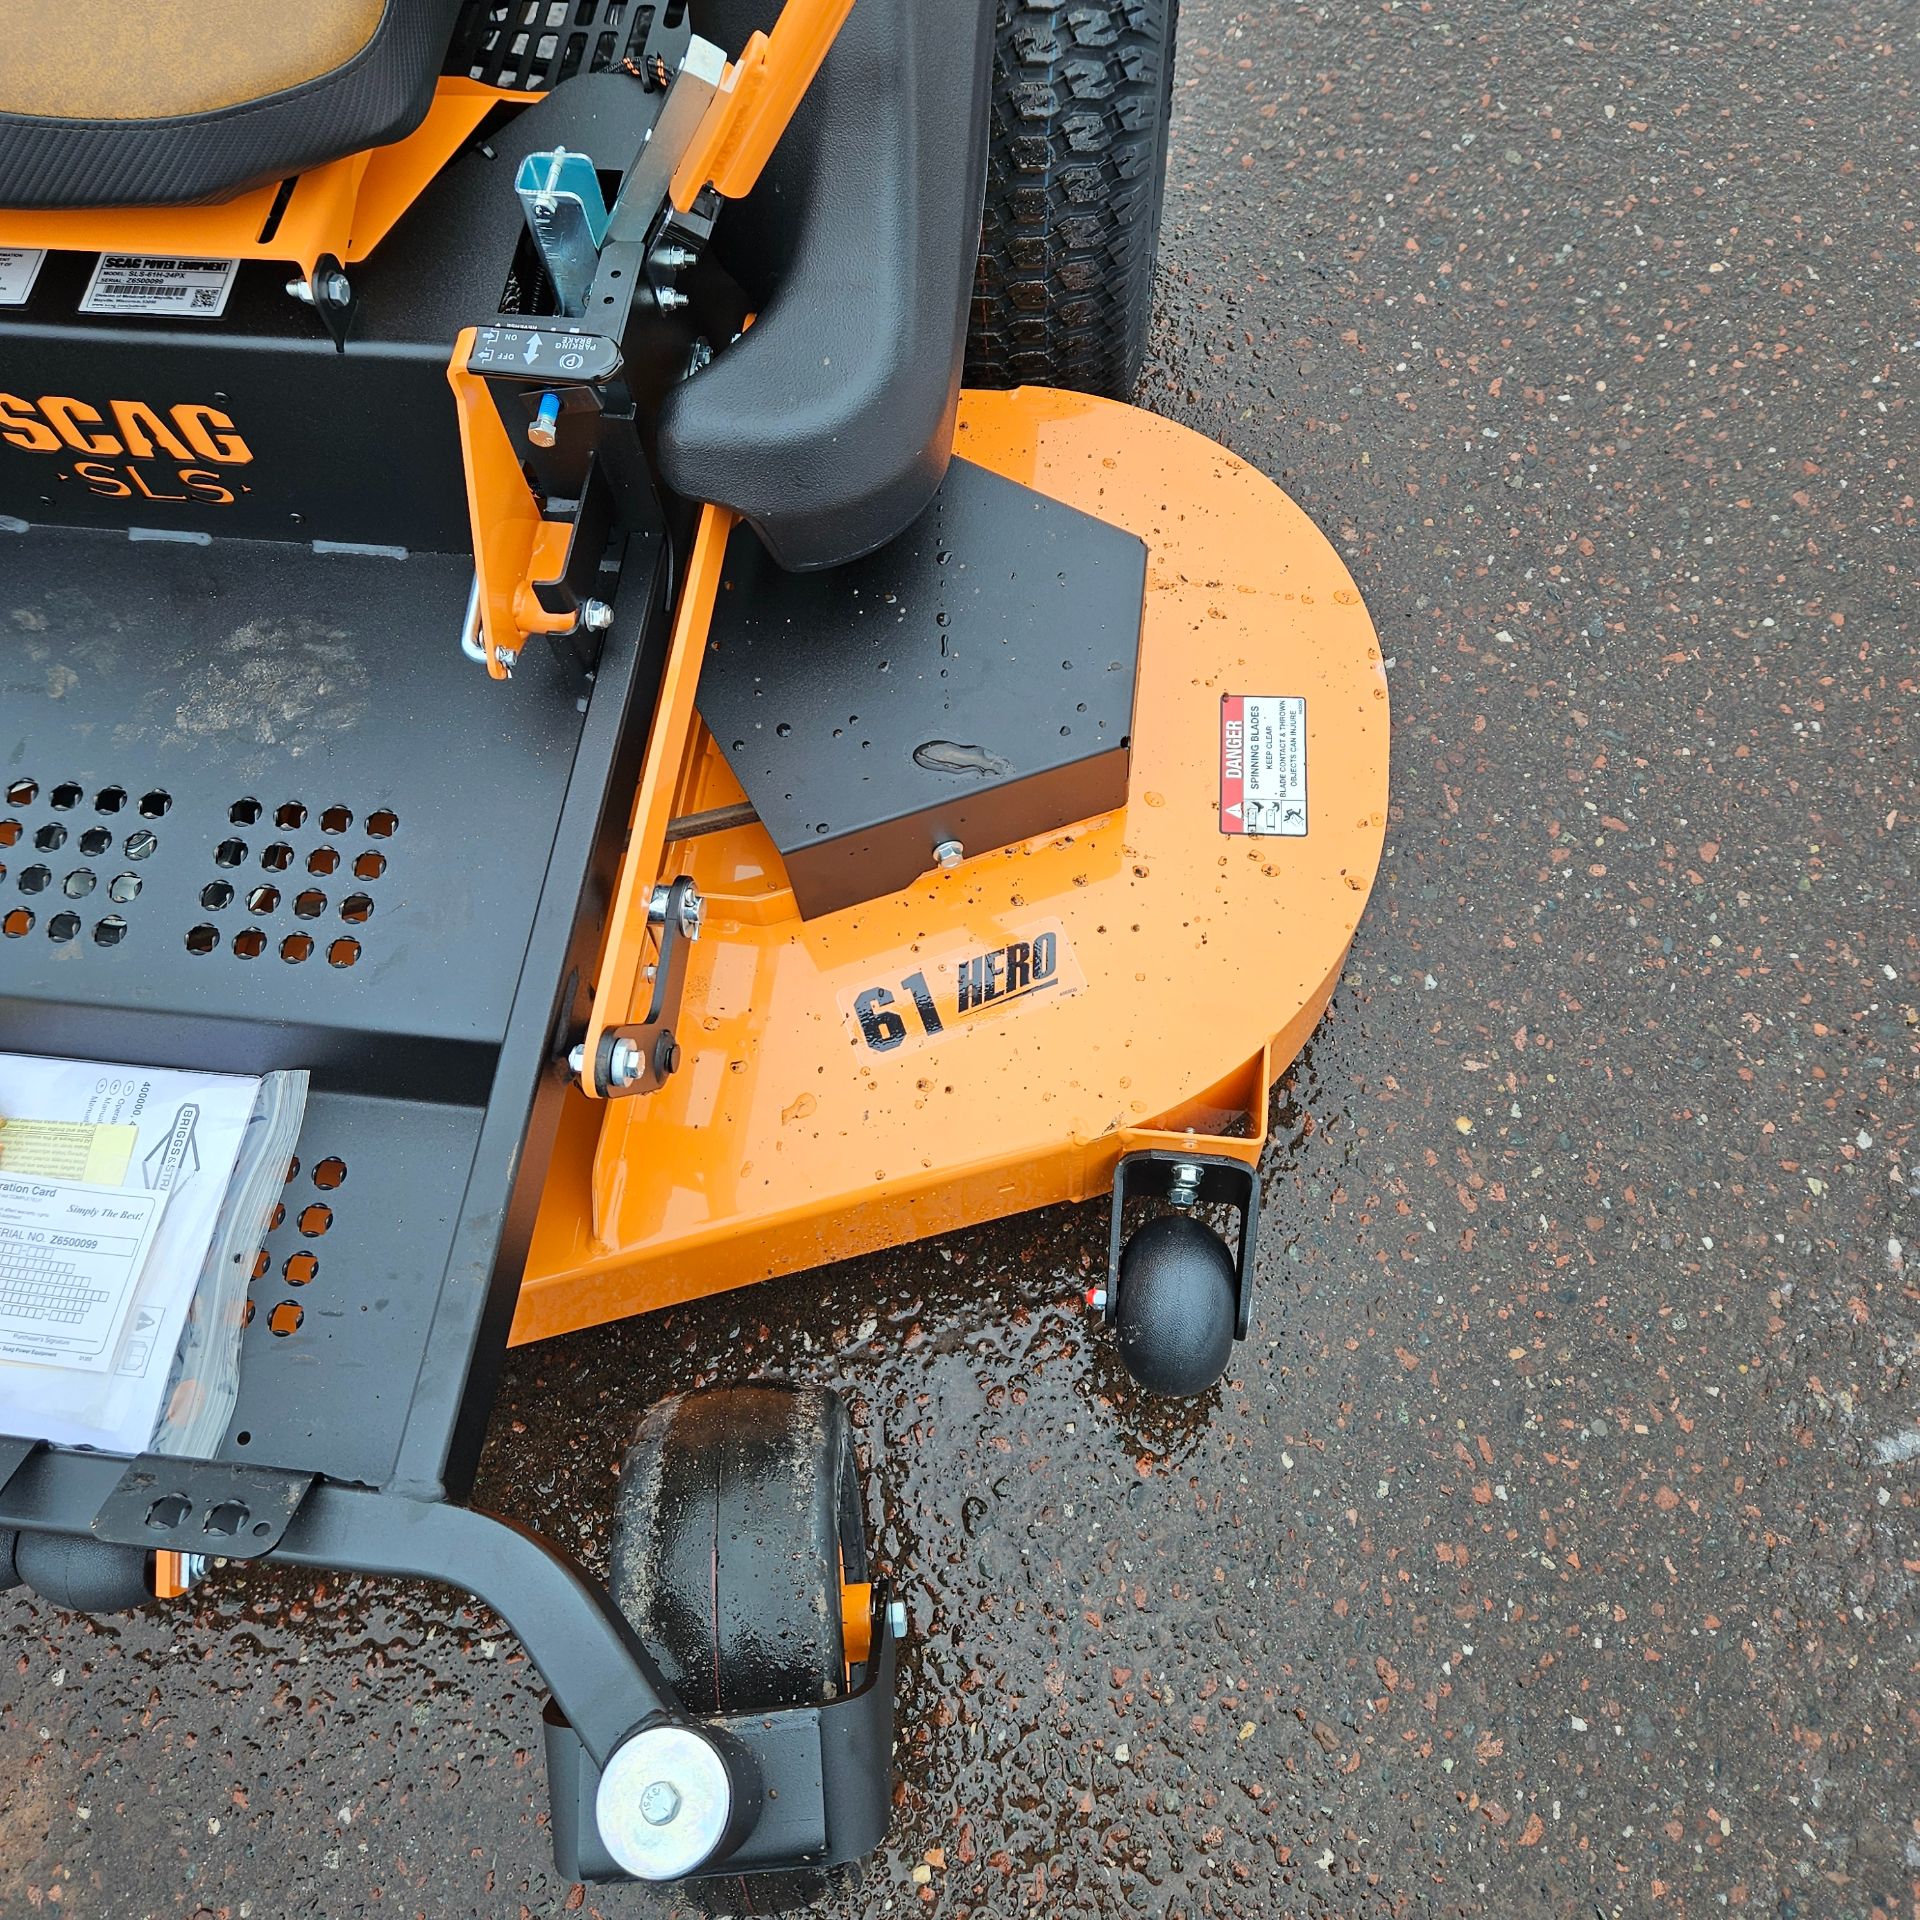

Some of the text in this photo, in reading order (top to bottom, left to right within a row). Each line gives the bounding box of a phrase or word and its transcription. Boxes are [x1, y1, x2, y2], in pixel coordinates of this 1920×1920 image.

[105, 258, 230, 271] SCAG POWER EQUIPMENT
[555, 342, 596, 351] PARKING
[562, 336, 592, 344] BRAKE
[0, 392, 254, 466] SCAG
[73, 461, 235, 505] SLS
[1226, 720, 1243, 780] DANGER
[1251, 706, 1260, 790] SPINNING BLADES
[853, 932, 1056, 1052] 61 HERO
[130, 1082, 151, 1118] 400000,
[32, 1186, 58, 1198] Card
[66, 1204, 144, 1220] Simply The Best!
[50, 1235, 98, 1249] Z6500099
